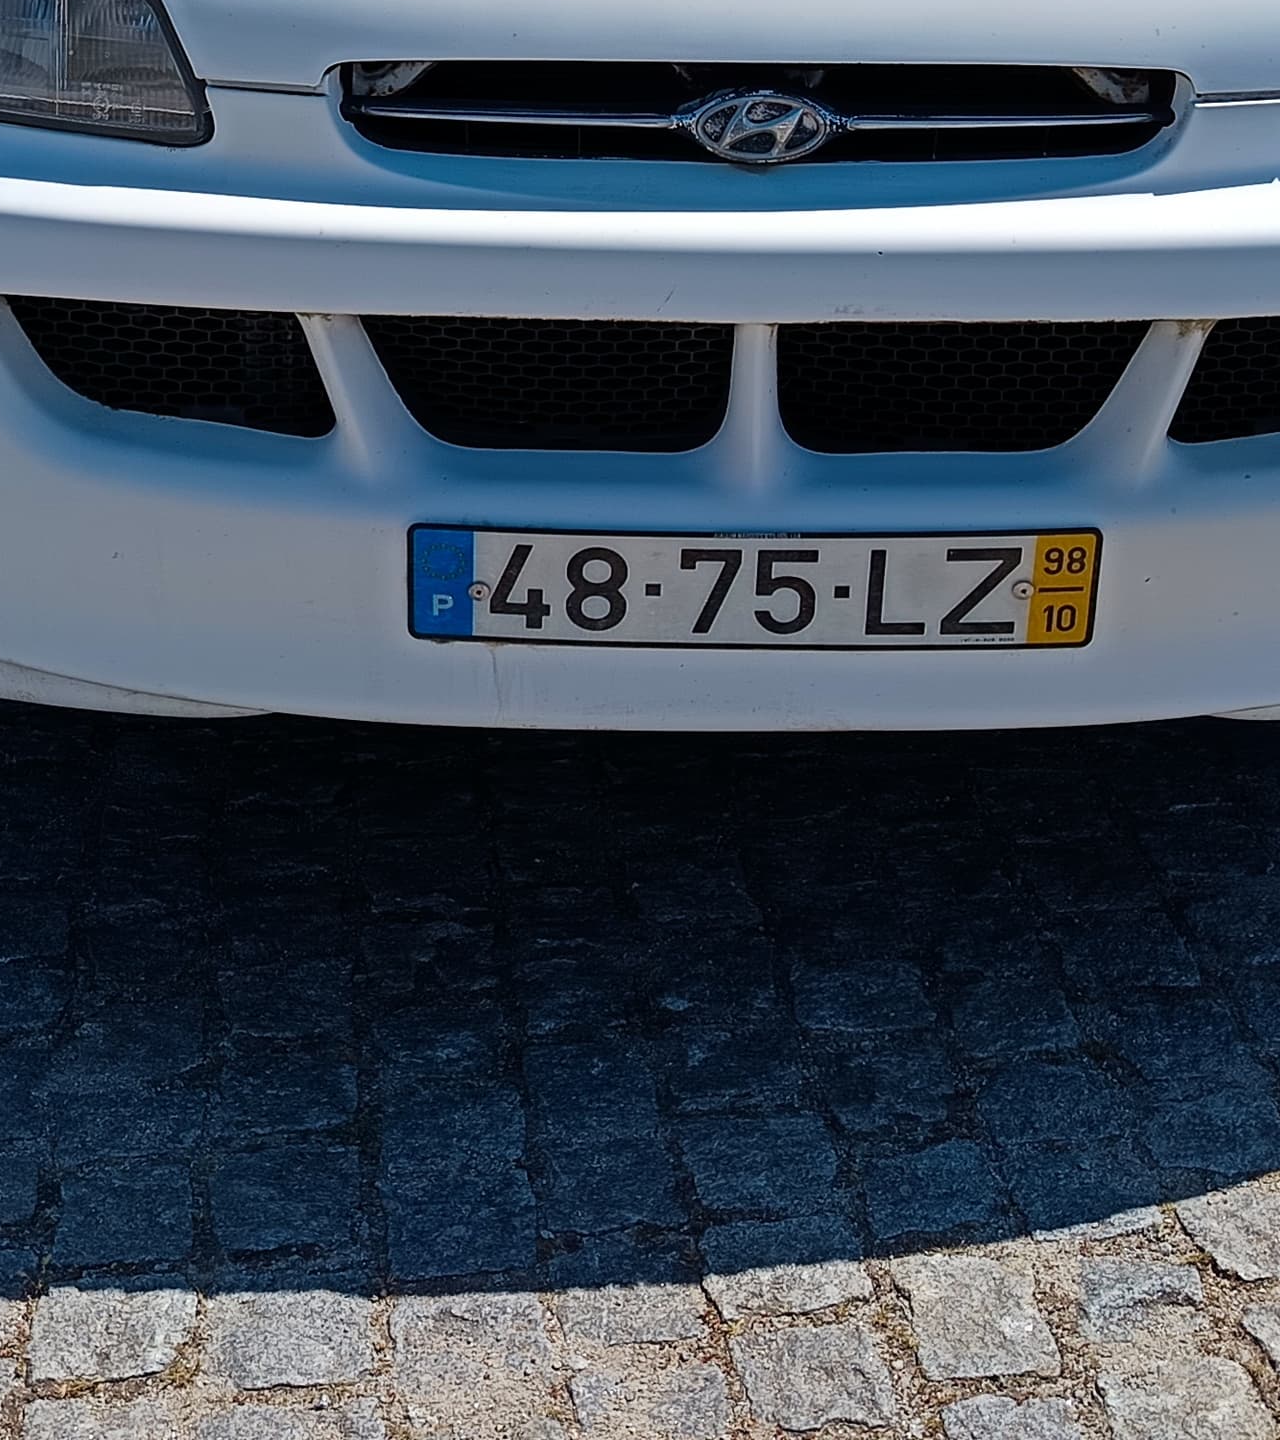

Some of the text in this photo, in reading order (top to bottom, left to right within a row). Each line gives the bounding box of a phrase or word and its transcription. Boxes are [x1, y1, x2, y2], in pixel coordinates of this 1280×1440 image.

[1042, 545, 1088, 575] 98
[431, 594, 455, 617] P
[1041, 604, 1078, 633] 10
